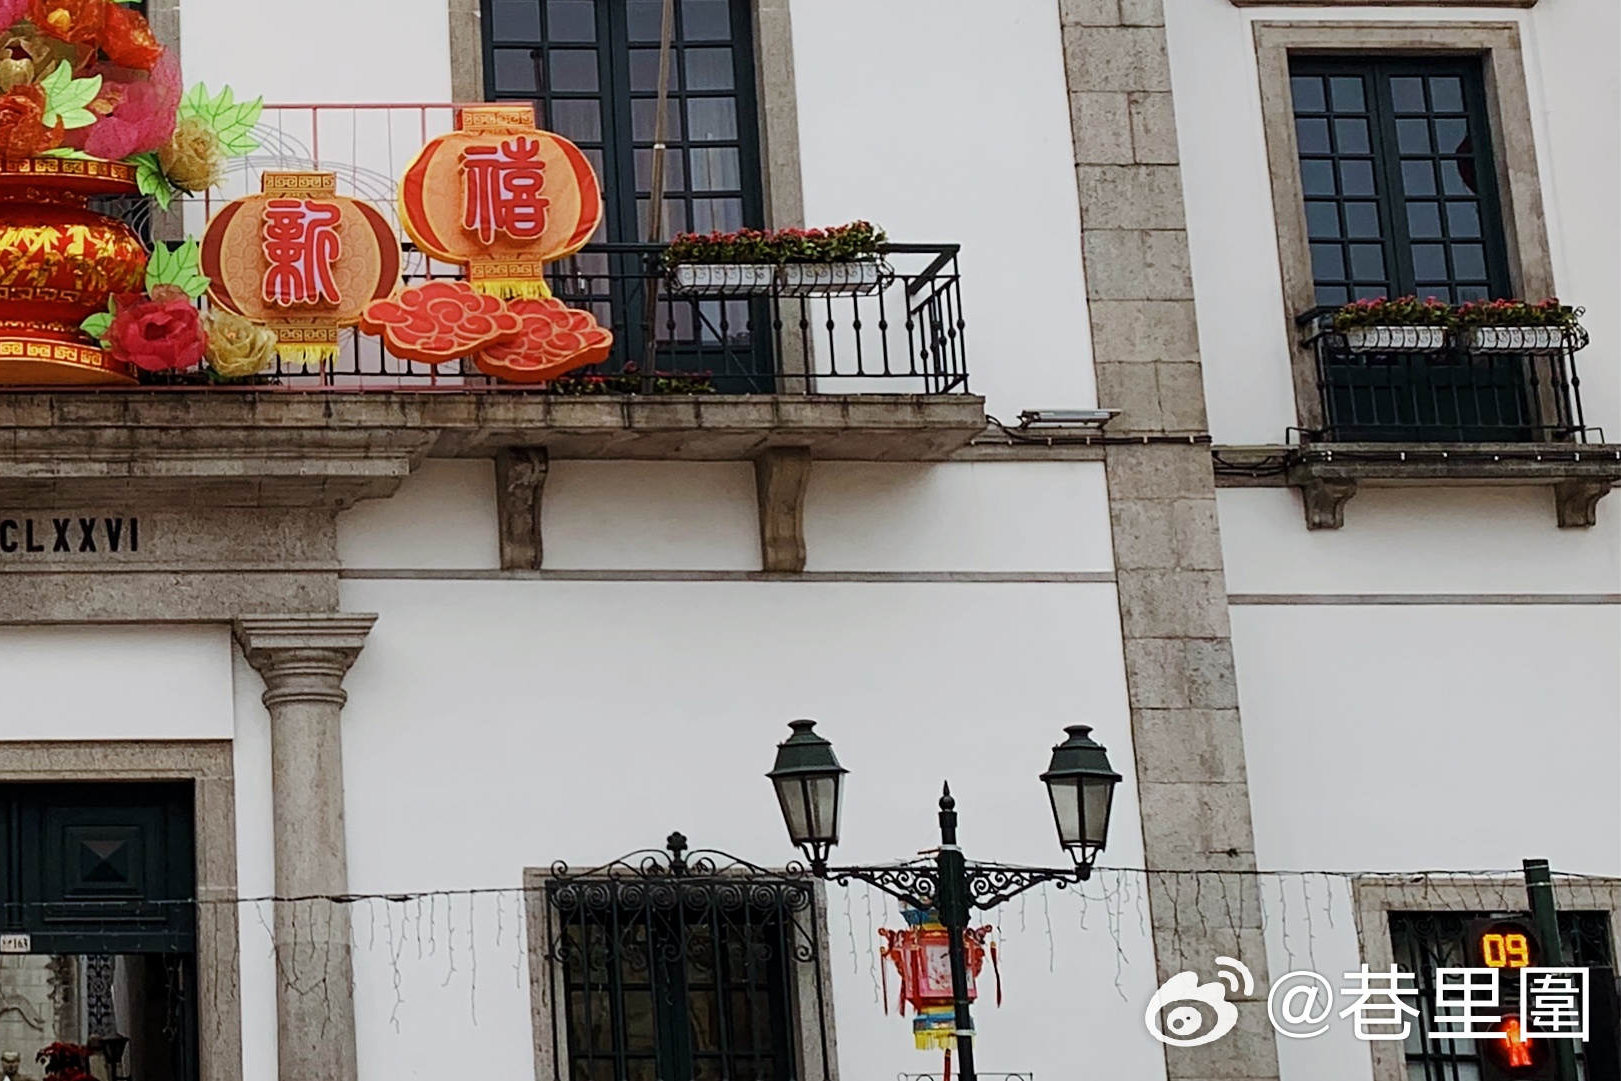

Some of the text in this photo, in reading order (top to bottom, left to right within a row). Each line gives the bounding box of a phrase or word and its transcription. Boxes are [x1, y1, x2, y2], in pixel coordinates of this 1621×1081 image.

[262, 198, 341, 306] 新
[463, 136, 550, 244] 禧
[1482, 933, 1530, 968] 09
